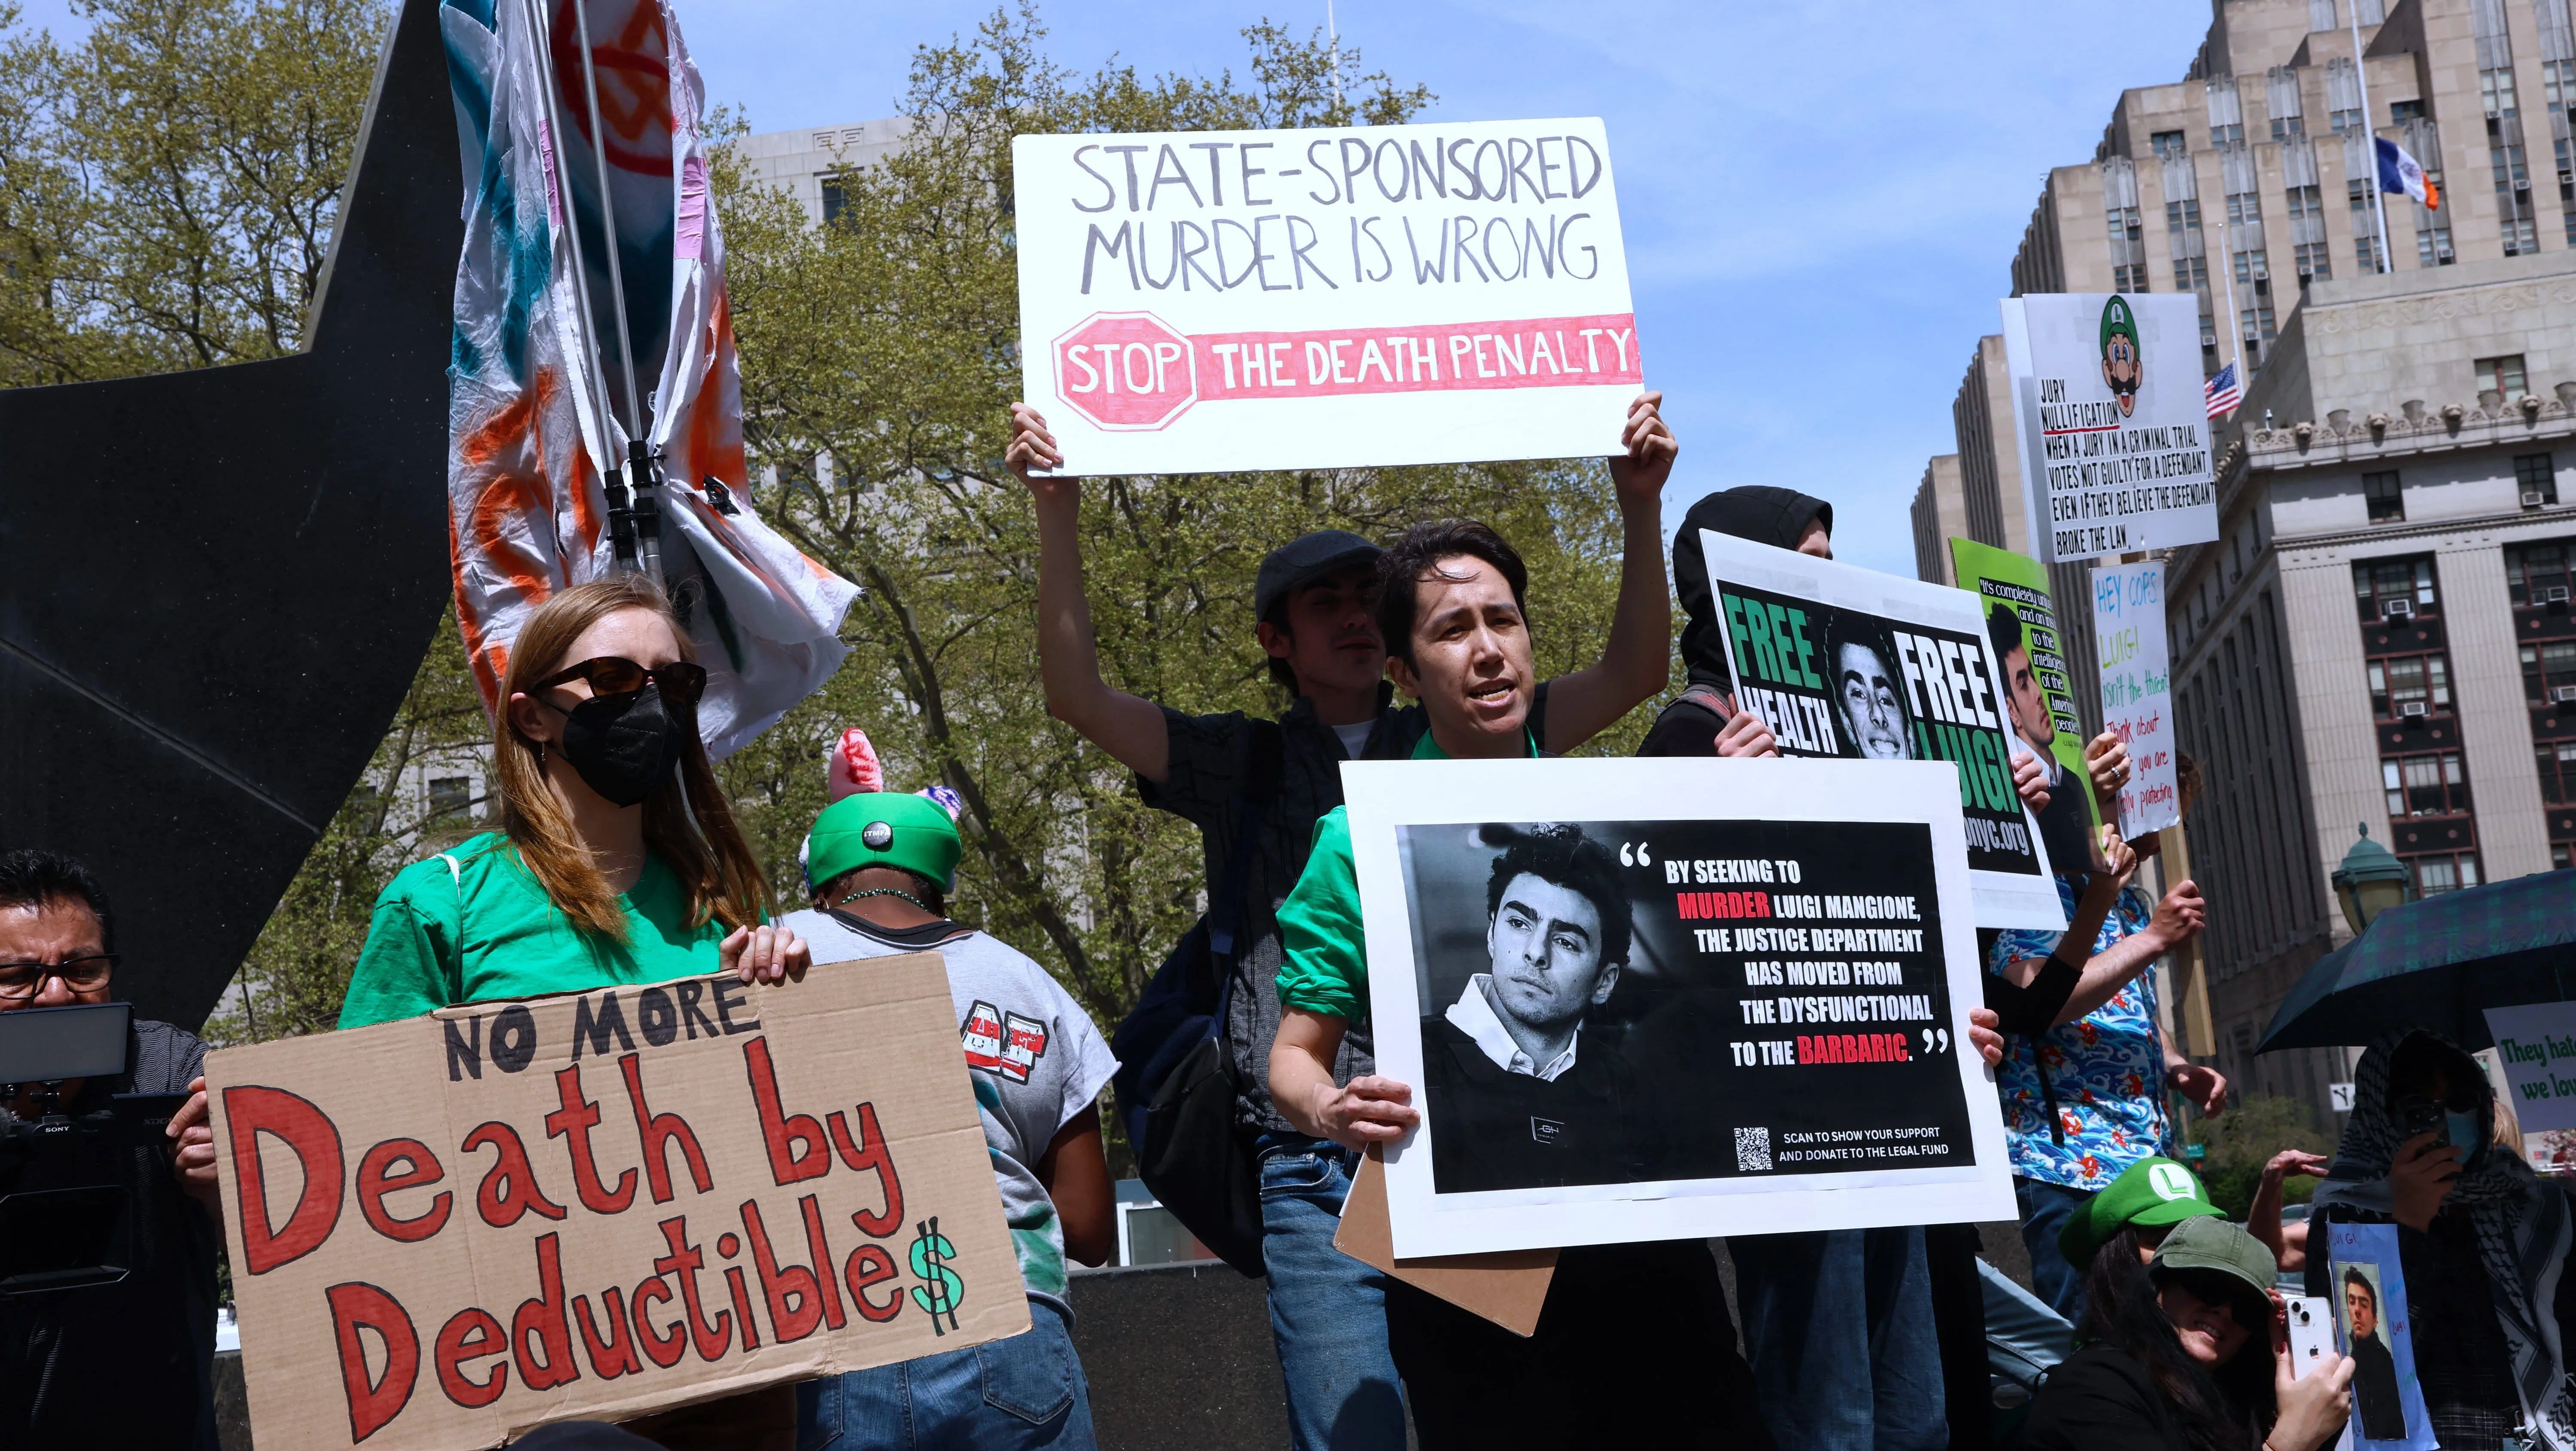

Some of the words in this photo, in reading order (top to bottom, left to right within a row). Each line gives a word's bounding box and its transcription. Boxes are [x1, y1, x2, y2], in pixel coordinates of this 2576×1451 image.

[1072, 136, 1601, 212] STATE-SPONSORED
[1081, 214, 1339, 294] MURDER
[1350, 216, 1392, 283] IS
[1402, 212, 1598, 285] WRONG
[1066, 343, 1181, 393] STOP
[1213, 344, 1297, 389] THE
[1306, 337, 1439, 386] DEATH
[1450, 328, 1632, 380] PENALTY
[2041, 379, 2065, 403] JURY
[2041, 401, 2119, 431] NULLIFICATION
[2045, 435, 2070, 460] WHEN
[2074, 434, 2080, 458] A
[2084, 432, 2104, 457] JURY
[2108, 431, 2119, 455] IN
[2122, 431, 2127, 454] A
[2129, 426, 2171, 453] CRIMINAL
[2172, 425, 2198, 449] TRIAL
[2048, 465, 2079, 491] VOTES
[2135, 456, 2152, 481] FOR
[2155, 456, 2160, 479] A
[2162, 451, 2210, 478] DEFENDANT,
[2052, 495, 2078, 522] EVEN
[2081, 492, 2090, 519] IF
[2090, 492, 2114, 518] THEY
[2117, 488, 2154, 516] BELIEVE
[2155, 486, 2171, 509] THE
[2172, 482, 2214, 508] DEFENDANT
[2056, 529, 2086, 556] BROKE
[2089, 526, 2106, 552] THE
[2109, 524, 2131, 550] LAW.
[1996, 584, 2037, 607] completely
[2037, 595, 2053, 610] unjus
[2096, 575, 2122, 618] HEY
[2129, 572, 2157, 606] COPS
[2020, 609, 2035, 622] and
[2035, 613, 2045, 625] an
[2045, 613, 2057, 631] ins
[1722, 592, 1823, 690] FREE
[2032, 631, 2041, 646] to
[2042, 632, 2054, 649] the
[2099, 625, 2140, 669] LUIGI
[2033, 651, 2068, 674] intelligenc
[1893, 631, 1998, 729] FREE
[2041, 673, 2050, 687] of
[2051, 674, 2063, 690] the
[2103, 672, 2123, 709] isn't
[2129, 672, 2142, 705] the
[1743, 686, 1839, 754] HEALTH
[2107, 718, 2134, 745] Think
[2136, 710, 2159, 736] about
[2139, 754, 2151, 780] you
[2155, 751, 2169, 767] are
[2118, 789, 2135, 823] really
[1665, 860, 1689, 883] BY
[1695, 859, 1774, 883] SEEKING
[1775, 860, 1801, 883] TO
[1677, 892, 1771, 920] MURDER
[1773, 895, 1821, 919] LUIGI
[1825, 895, 1921, 922] MANGIONE,
[1694, 929, 1732, 953] THE
[1735, 928, 1807, 952] JUSTICE
[1812, 929, 1923, 952] DEPARTMENT
[1744, 961, 1783, 986] HAS
[1787, 962, 1850, 985] MOVED
[1853, 962, 1902, 985] FROM
[1740, 999, 1777, 1024] THE
[1779, 994, 1934, 1023] DYSFUNCTIONAL
[443, 1004, 538, 1082] NO
[570, 977, 763, 1062] MORE
[1730, 1042, 1756, 1066] TO
[1759, 1041, 1795, 1065] THE
[1797, 1033, 1913, 1064] BARBARIC.
[2500, 1038, 2547, 1067] They
[2545, 1035, 2576, 1059] hat
[2520, 1081, 2550, 1101] we
[2549, 1073, 2576, 1097] lov
[1784, 1131, 1814, 1144] SCAN
[1815, 1132, 1830, 1142] TO
[1831, 1131, 1863, 1142] SHOW
[1864, 1129, 1893, 1141] YOUR
[1895, 1127, 1940, 1139] SUPPORT
[222, 1052, 714, 1277] Death
[742, 1035, 904, 1240] by
[1779, 1150, 1802, 1162] AND
[1806, 1148, 1849, 1161] DONATE
[1850, 1148, 1864, 1159] TO
[1865, 1147, 1886, 1157] THE
[1888, 1145, 1920, 1157] LEGAL
[1922, 1144, 1949, 1155] FUND
[2158, 1168, 2190, 1194] L
